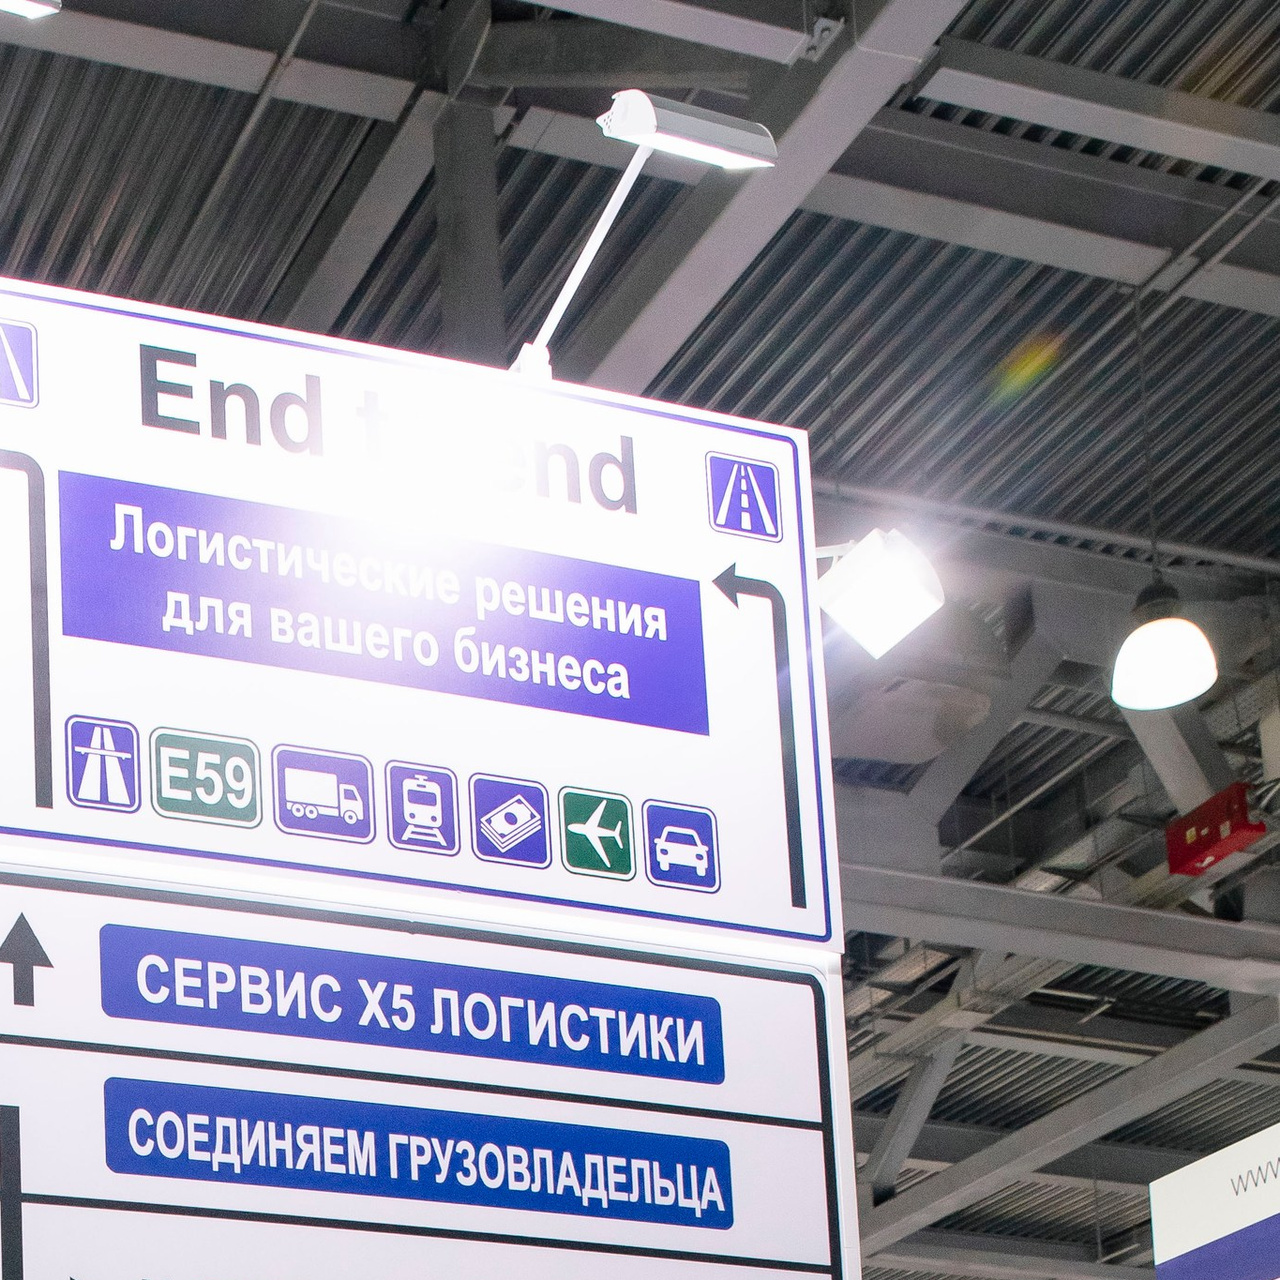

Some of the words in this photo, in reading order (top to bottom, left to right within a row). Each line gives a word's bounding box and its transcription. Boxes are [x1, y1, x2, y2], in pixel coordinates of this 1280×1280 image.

[139, 344, 324, 456] End
[492, 434, 638, 514] nd
[110, 504, 460, 605] Логистические
[475, 573, 668, 642] решения
[162, 590, 252, 639] для
[270, 606, 439, 667] вашего
[453, 626, 630, 700] бизнеса
[160, 745, 254, 808] E59
[135, 953, 342, 1023] СЕРВИС
[358, 981, 416, 1033] X5
[429, 987, 706, 1066] ЛОГИСТИКИ
[128, 1106, 376, 1177] СОЕДИНЯЕМ
[388, 1133, 726, 1218] ГРУЗОВЛАДЕЛЬЦА
[1230, 1156, 1280, 1197] ww
